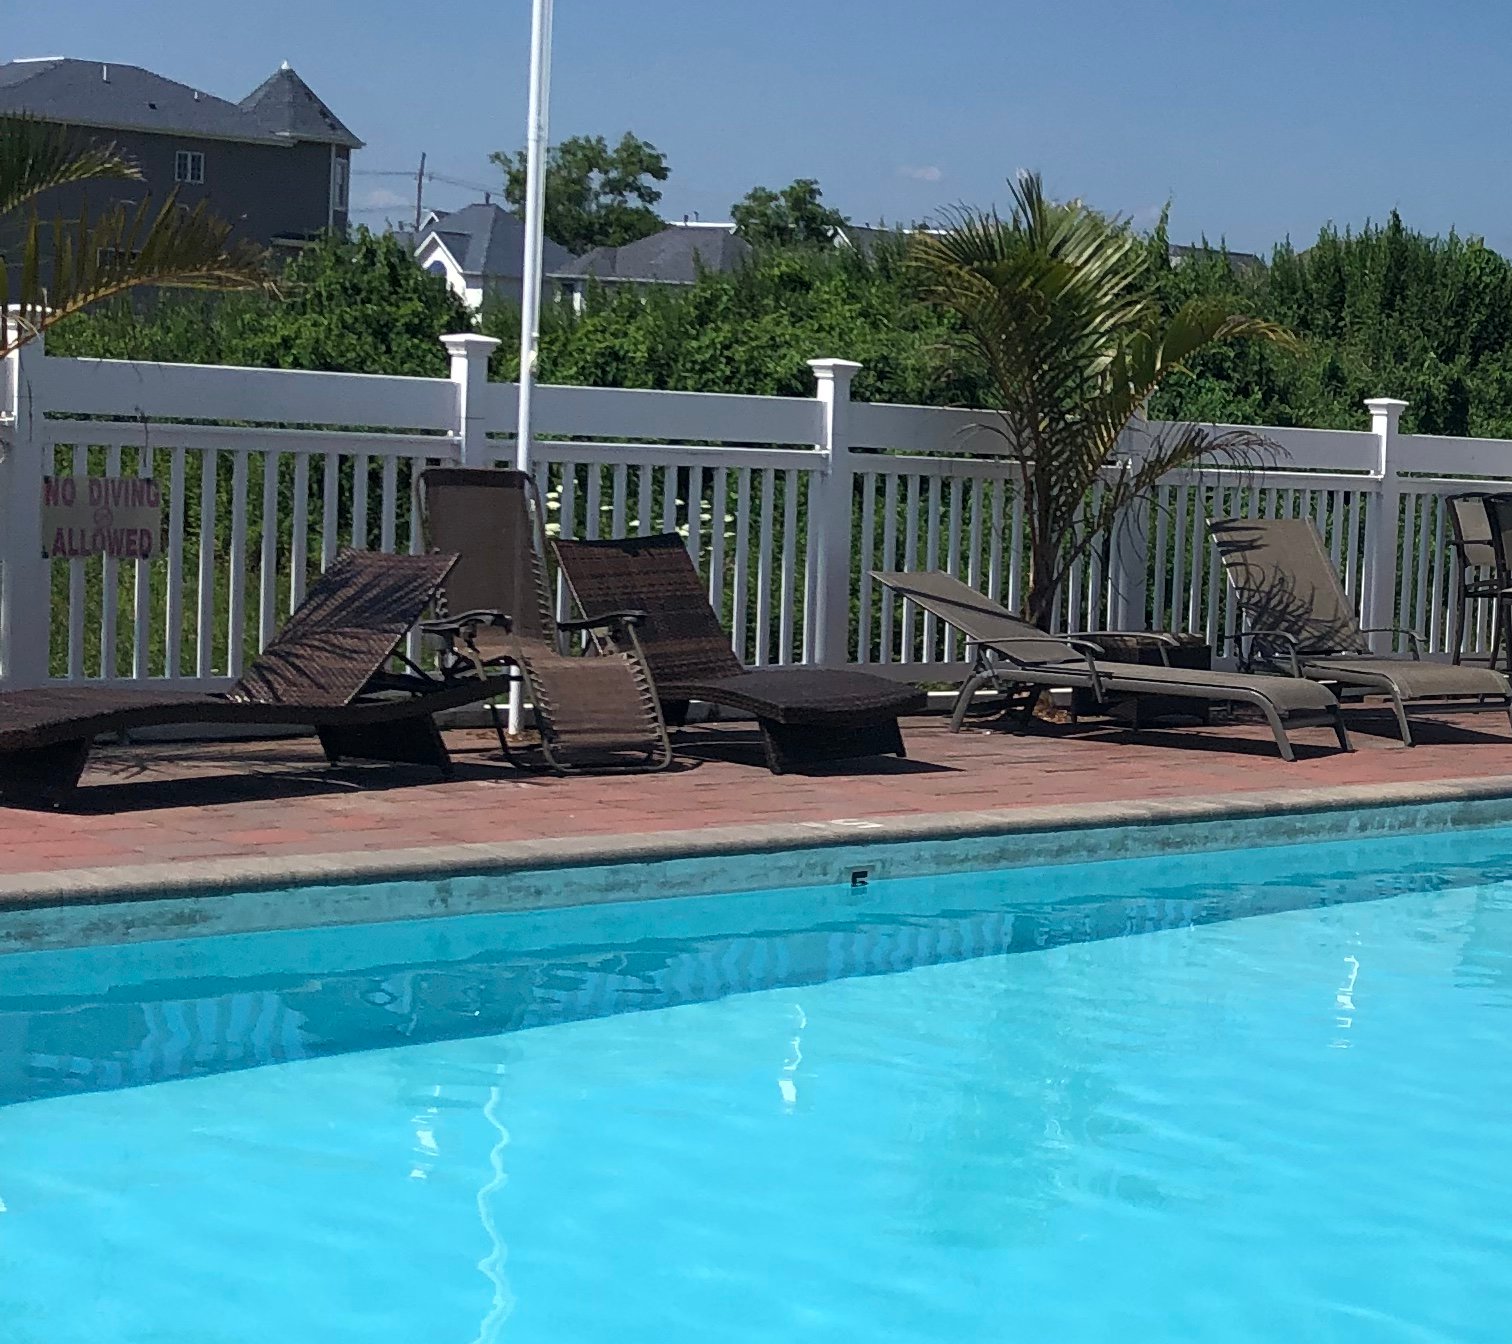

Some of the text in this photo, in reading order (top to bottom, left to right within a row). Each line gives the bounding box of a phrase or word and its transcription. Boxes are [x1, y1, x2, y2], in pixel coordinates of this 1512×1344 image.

[44, 477, 160, 507] NO DIVING
[52, 527, 153, 557] ALLOWED
